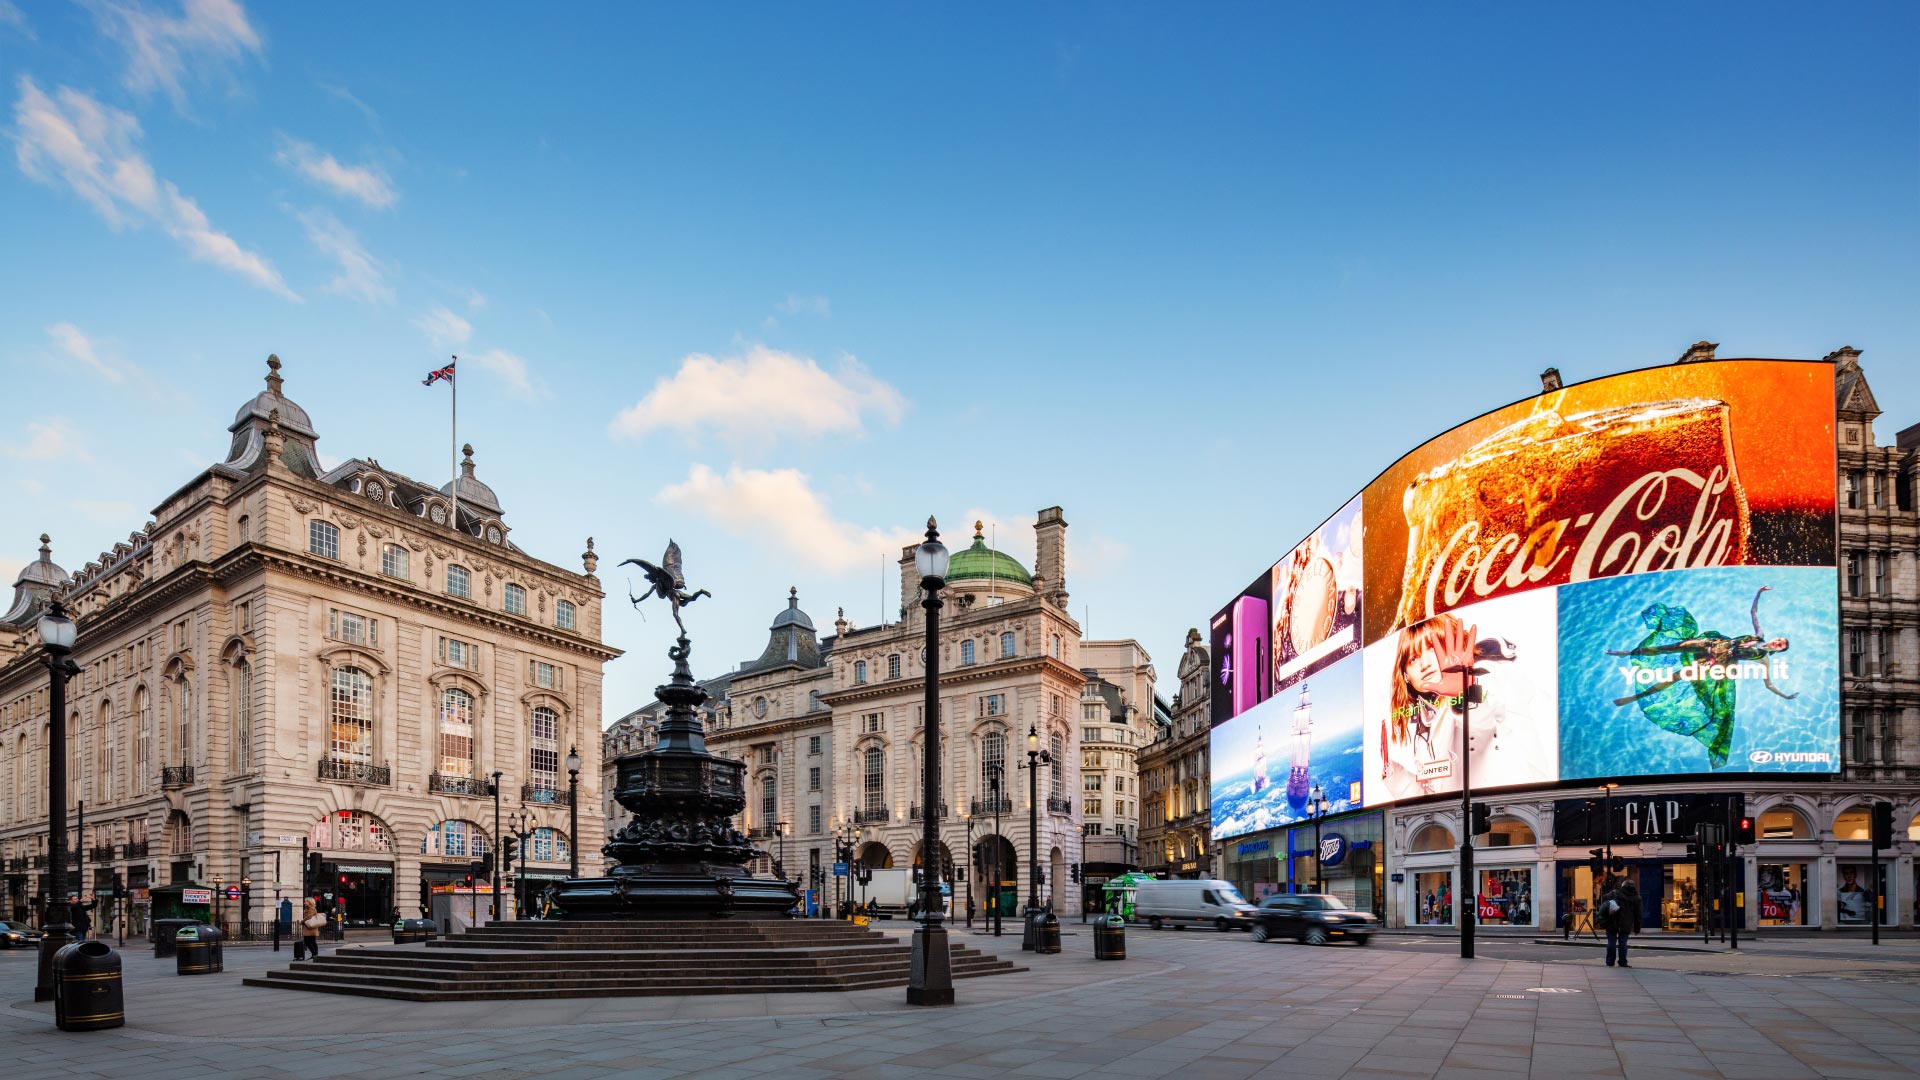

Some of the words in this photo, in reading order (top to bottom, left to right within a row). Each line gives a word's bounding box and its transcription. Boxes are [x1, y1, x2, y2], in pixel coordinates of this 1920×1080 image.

[1426, 465, 1733, 617] Coca-Cola
[1619, 665, 1674, 685] You
[1680, 661, 1768, 681] dream
[1773, 661, 1789, 680] it
[1775, 752, 1830, 763] HYUNDAI
[1625, 800, 1679, 836] GAP
[1320, 838, 1340, 860] Boots
